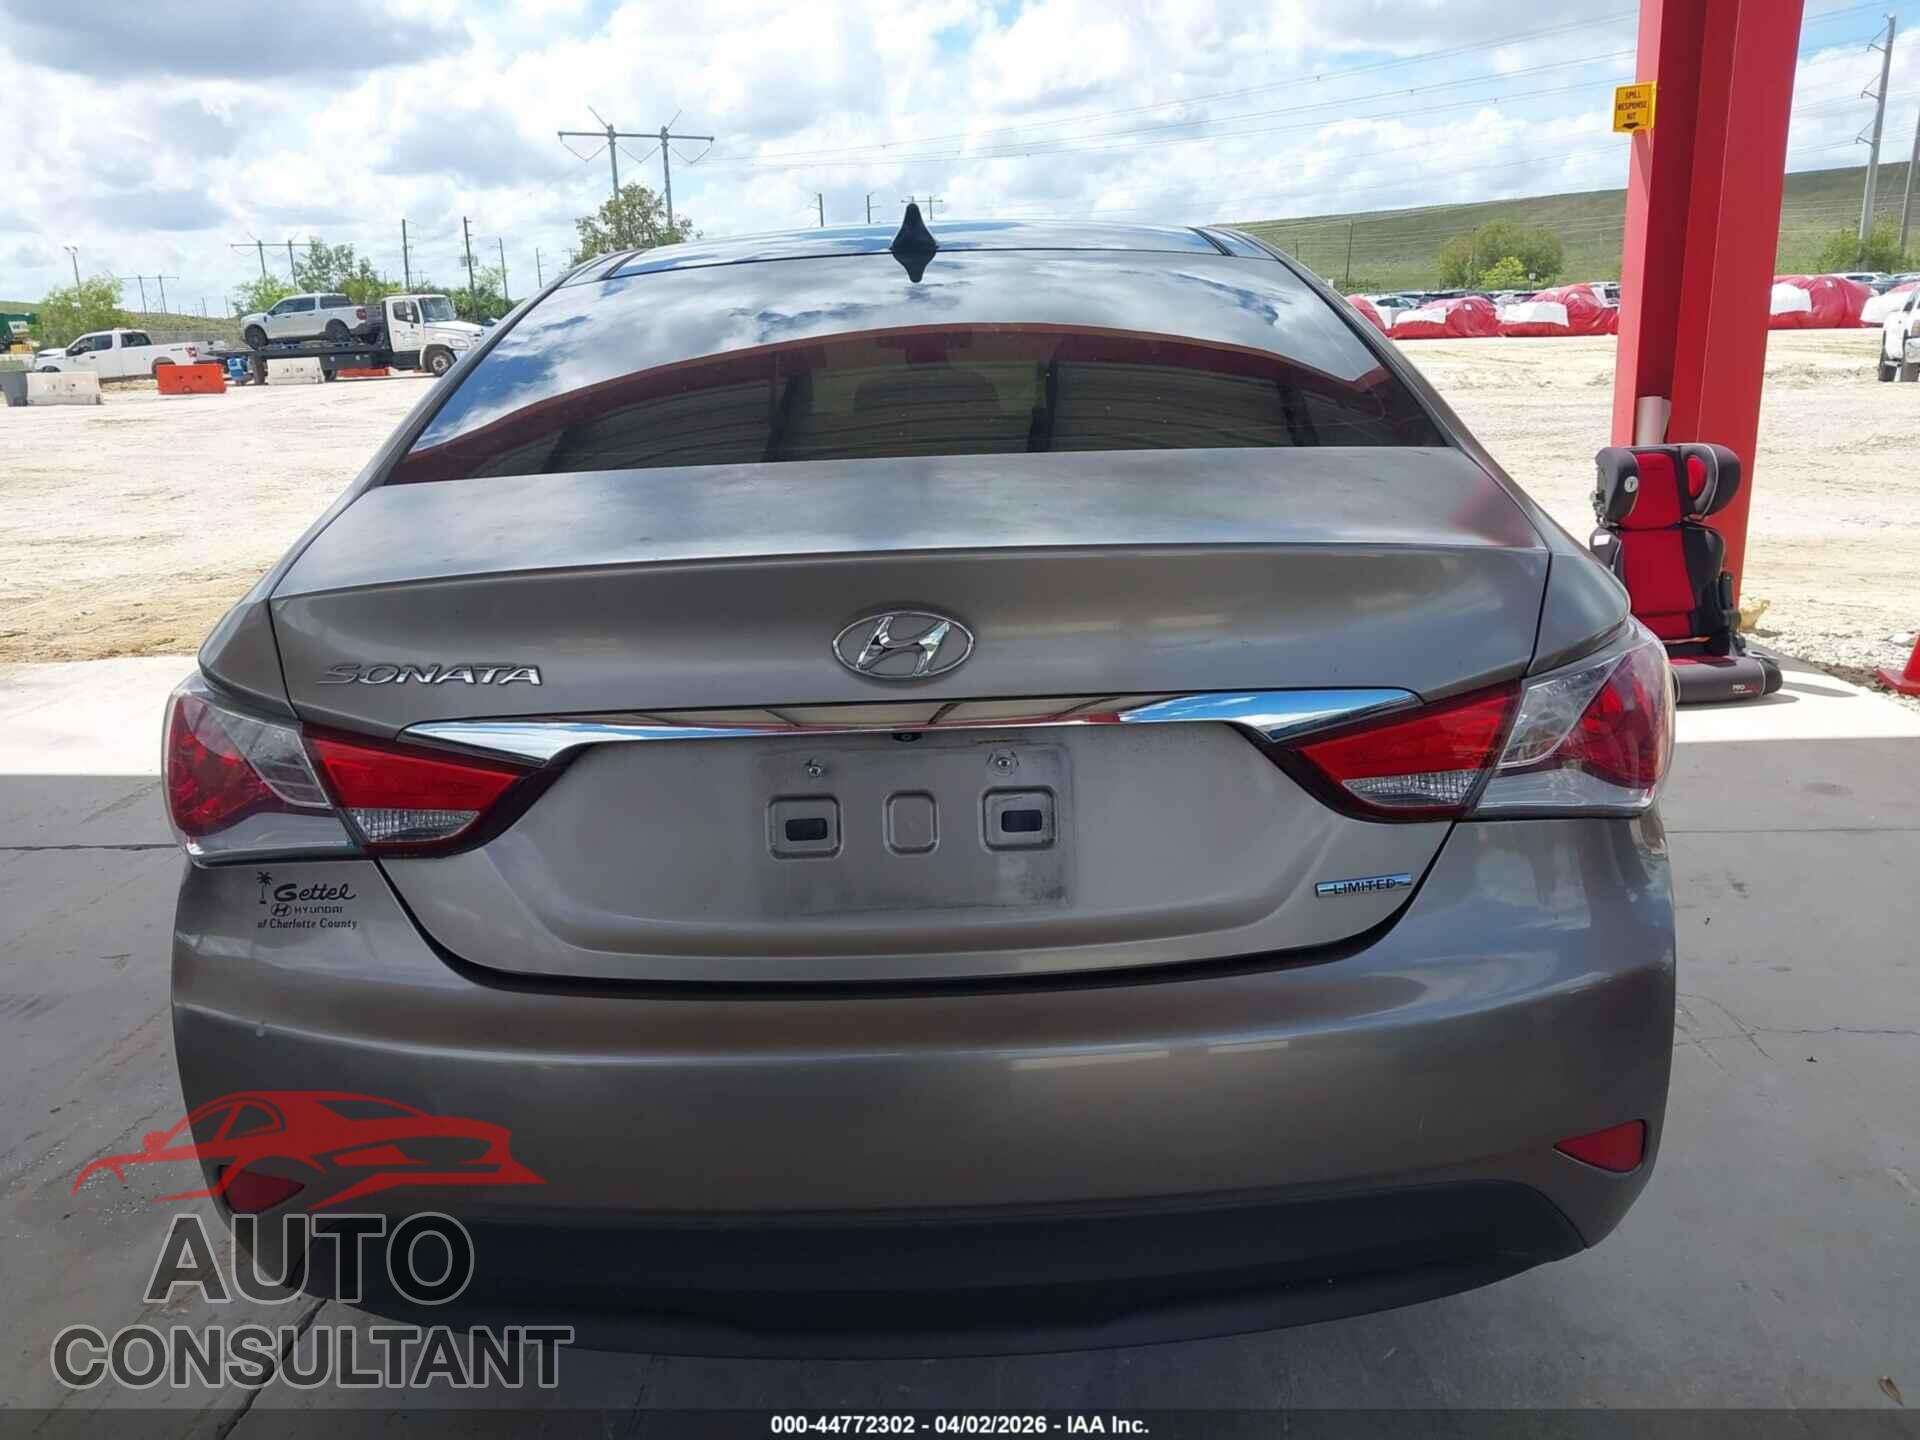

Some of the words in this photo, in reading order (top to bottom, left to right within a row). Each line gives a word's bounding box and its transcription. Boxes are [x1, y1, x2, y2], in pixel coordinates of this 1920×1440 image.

[1617, 101, 1648, 111] RESPONSE
[316, 663, 543, 686] SONATA
[274, 883, 357, 902] Gettel
[1334, 879, 1396, 895] LIMITED
[294, 905, 343, 914] HYUNDAI
[270, 918, 317, 929] Charlotte
[319, 918, 358, 930] County
